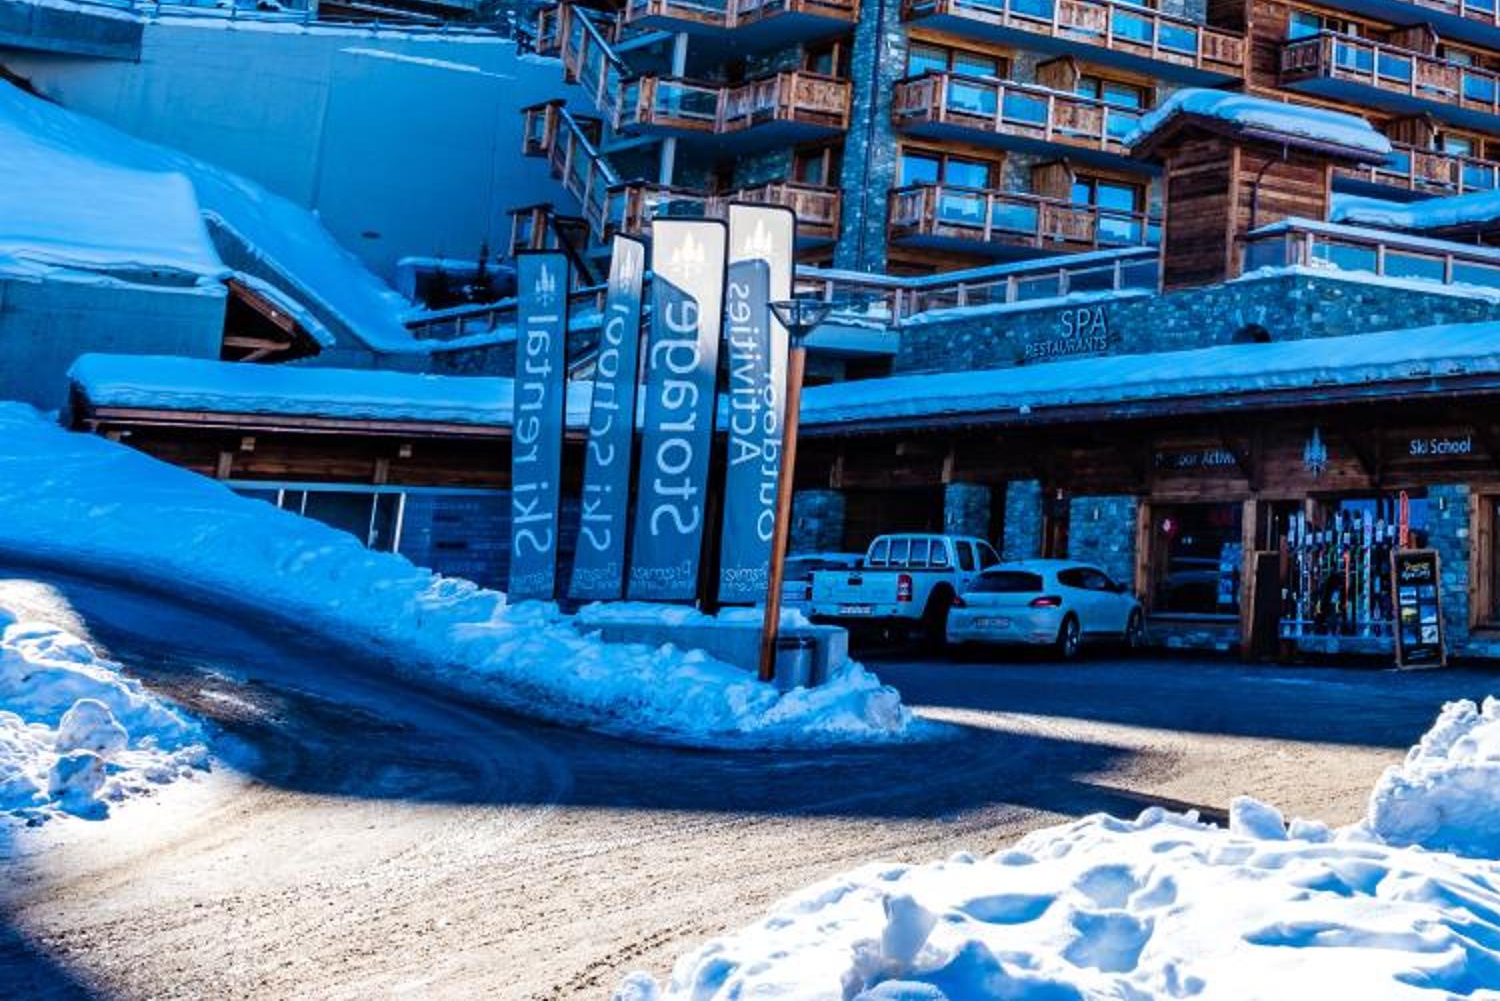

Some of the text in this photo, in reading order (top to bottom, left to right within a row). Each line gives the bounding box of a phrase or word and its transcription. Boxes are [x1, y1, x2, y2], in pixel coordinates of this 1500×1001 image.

[1061, 305, 1107, 341] SPA
[1025, 336, 1107, 358] RESTAURANTS
[1409, 437, 1471, 455] Ski School
